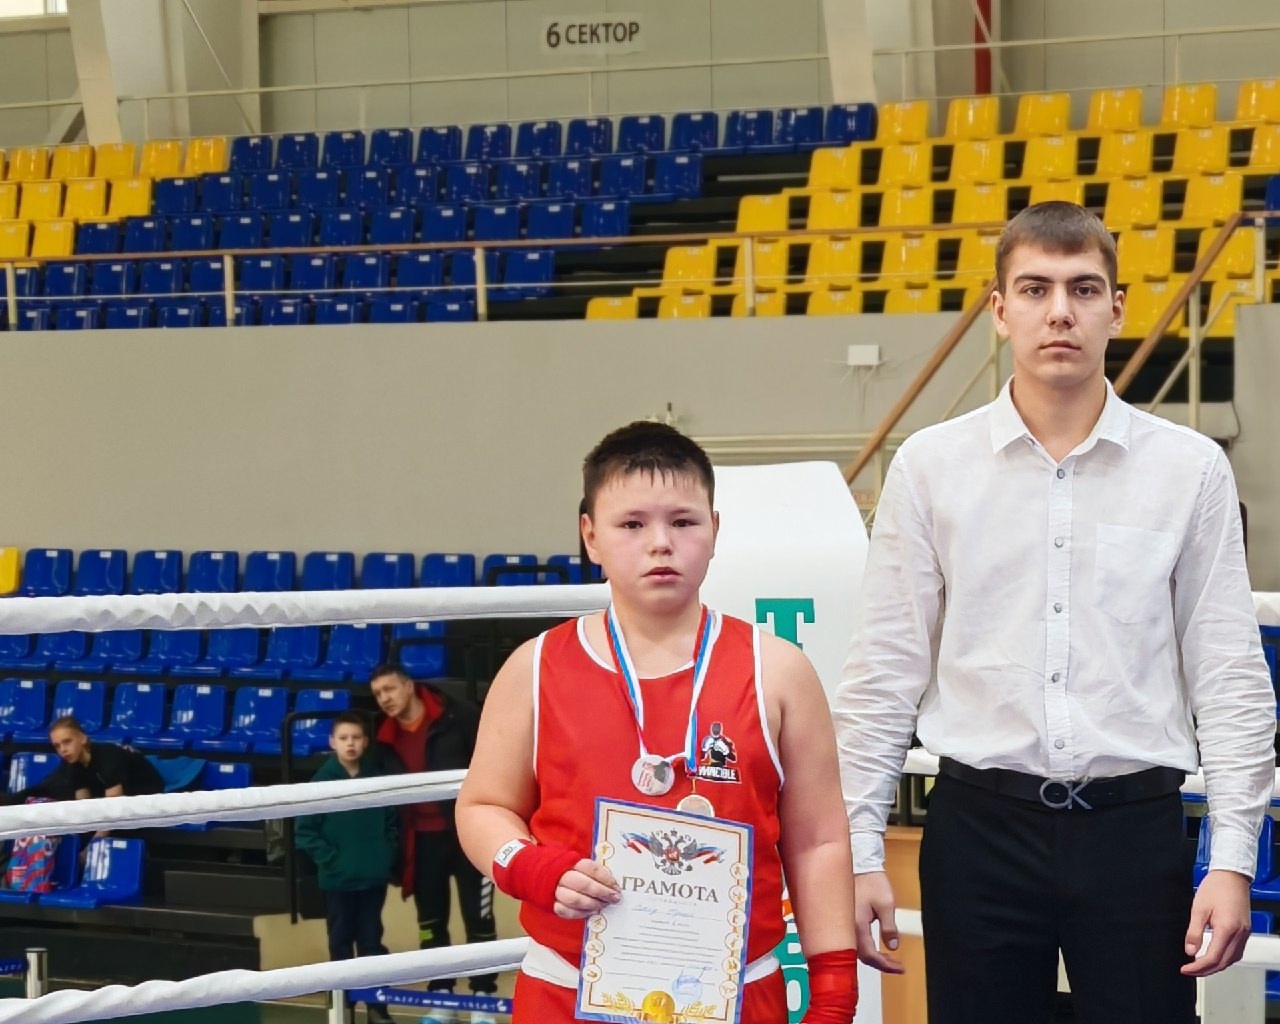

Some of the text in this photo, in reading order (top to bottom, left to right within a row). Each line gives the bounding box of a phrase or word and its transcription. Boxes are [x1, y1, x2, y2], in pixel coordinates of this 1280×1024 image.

[546, 21, 640, 48] 6 СЕКТОР
[622, 876, 719, 903] ГРАМОТА
